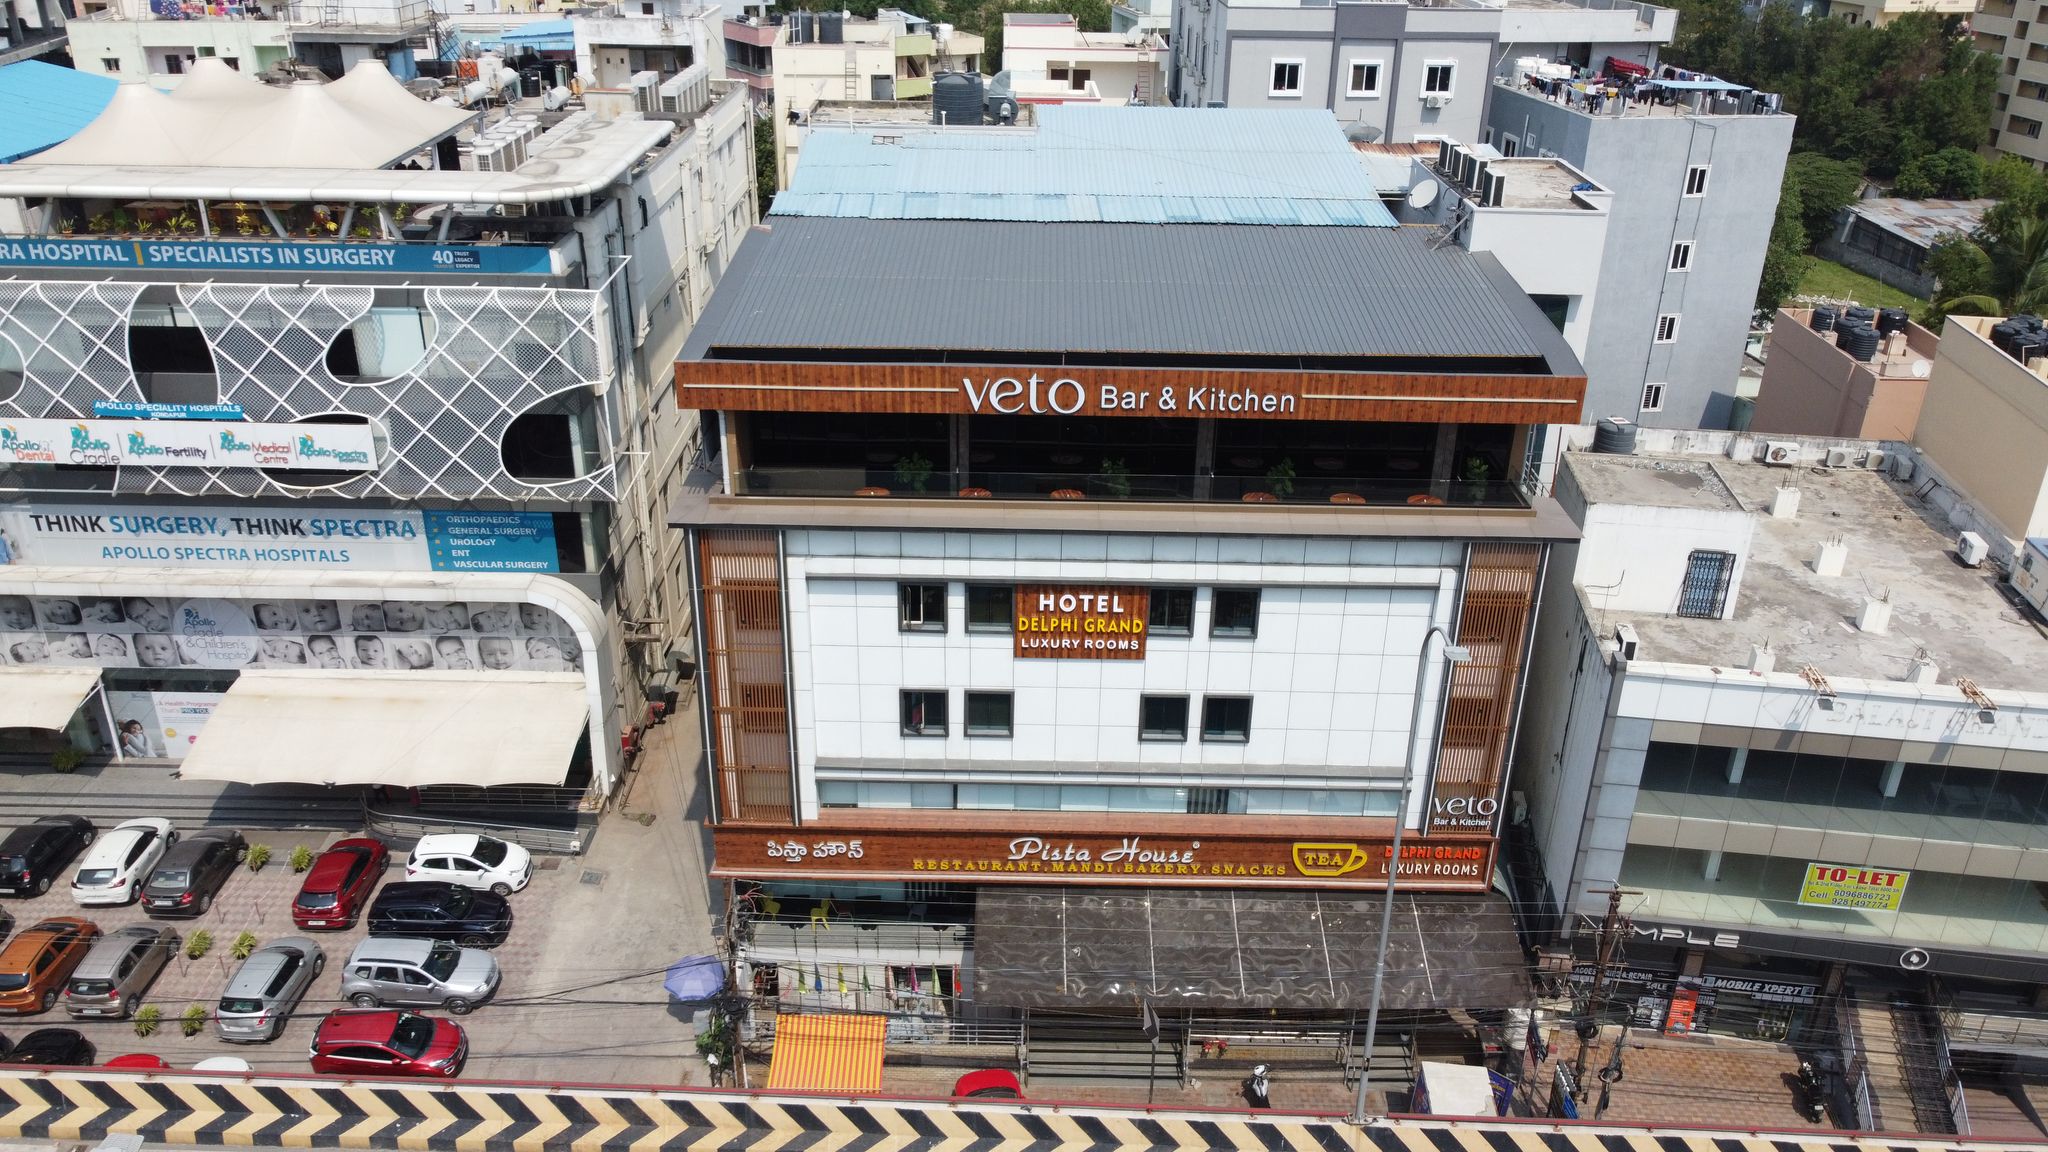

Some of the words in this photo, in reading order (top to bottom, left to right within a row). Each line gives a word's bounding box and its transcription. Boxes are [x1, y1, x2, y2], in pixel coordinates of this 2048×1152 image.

[29, 243, 129, 262] HOSPITAL
[149, 245, 273, 264] SPECIALISTS
[278, 248, 300, 264] IN
[304, 248, 395, 266] SURGERY
[432, 250, 453, 264] 40
[963, 372, 1085, 414] veto
[1101, 385, 1149, 409] Bar
[1158, 387, 1178, 410] &
[1188, 386, 1295, 413] Kitchen
[95, 402, 132, 411] APOLLO
[135, 404, 187, 412] SPECIALITY
[0, 439, 40, 454] Apollo
[71, 437, 110, 451] Apollo
[252, 442, 291, 453] Medical
[16, 450, 56, 462] Dental
[70, 449, 120, 464] Cradle
[128, 445, 164, 458] Apollo
[165, 447, 207, 459] Fertility
[254, 453, 289, 464] Centre
[30, 514, 106, 533] THINK
[108, 516, 228, 537] SURGERY,
[230, 518, 305, 536] THINK
[310, 519, 416, 537] SPECTRA
[446, 516, 520, 524] ORTHOPAEDICS
[102, 546, 170, 560] APOLLO
[175, 547, 250, 561] SPECTRA
[254, 549, 350, 563] HOSPITALS
[1039, 594, 1124, 613] HOTEL
[184, 618, 216, 628] Apollo
[1018, 617, 1078, 633] DELPHI
[1084, 619, 1143, 634] GRAND
[183, 626, 223, 637] Cradle
[1021, 638, 1080, 649] LUXURY
[1084, 639, 1139, 650] ROOMS
[1434, 795, 1498, 816] veto
[1434, 817, 1449, 825] Bar
[1460, 818, 1491, 826] Kitchen
[1008, 837, 1092, 861] Pista
[1385, 845, 1431, 859] DLPHI
[1434, 846, 1481, 859] GRAND
[1304, 853, 1343, 866] TEA
[1211, 865, 1287, 875] SNACKS
[1434, 864, 1479, 876] ROOMS
[1816, 867, 1900, 886] TO-LET
[1809, 890, 1828, 898] Cell
[1834, 889, 1891, 901] 8096886723
[1832, 897, 1888, 909] 9281497774
[1715, 980, 1762, 991] MOBILE
[1763, 984, 1802, 995] XPERT
